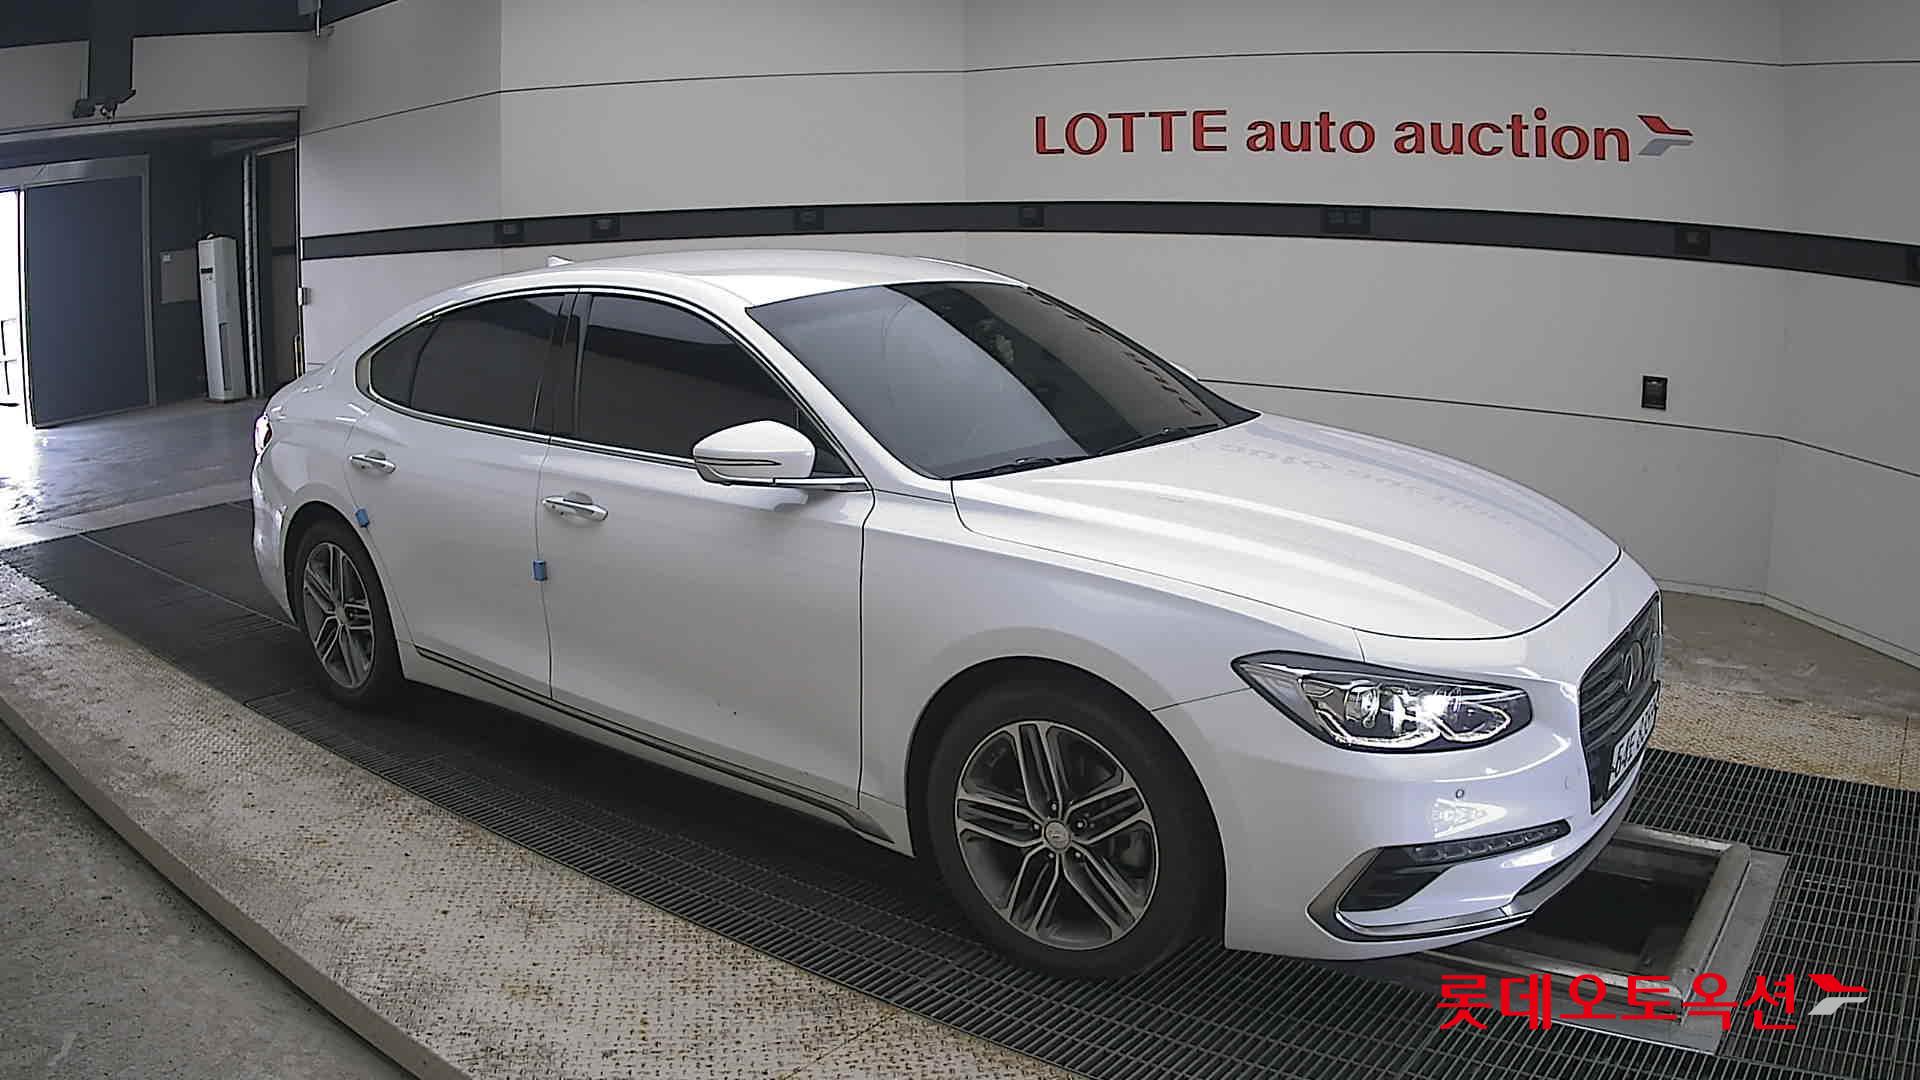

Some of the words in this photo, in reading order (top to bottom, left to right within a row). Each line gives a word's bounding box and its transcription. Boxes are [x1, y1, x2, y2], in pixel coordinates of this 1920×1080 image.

[1035, 110, 1227, 155] LOTTE
[1246, 111, 1376, 154] auto
[1394, 107, 1631, 162] auction
